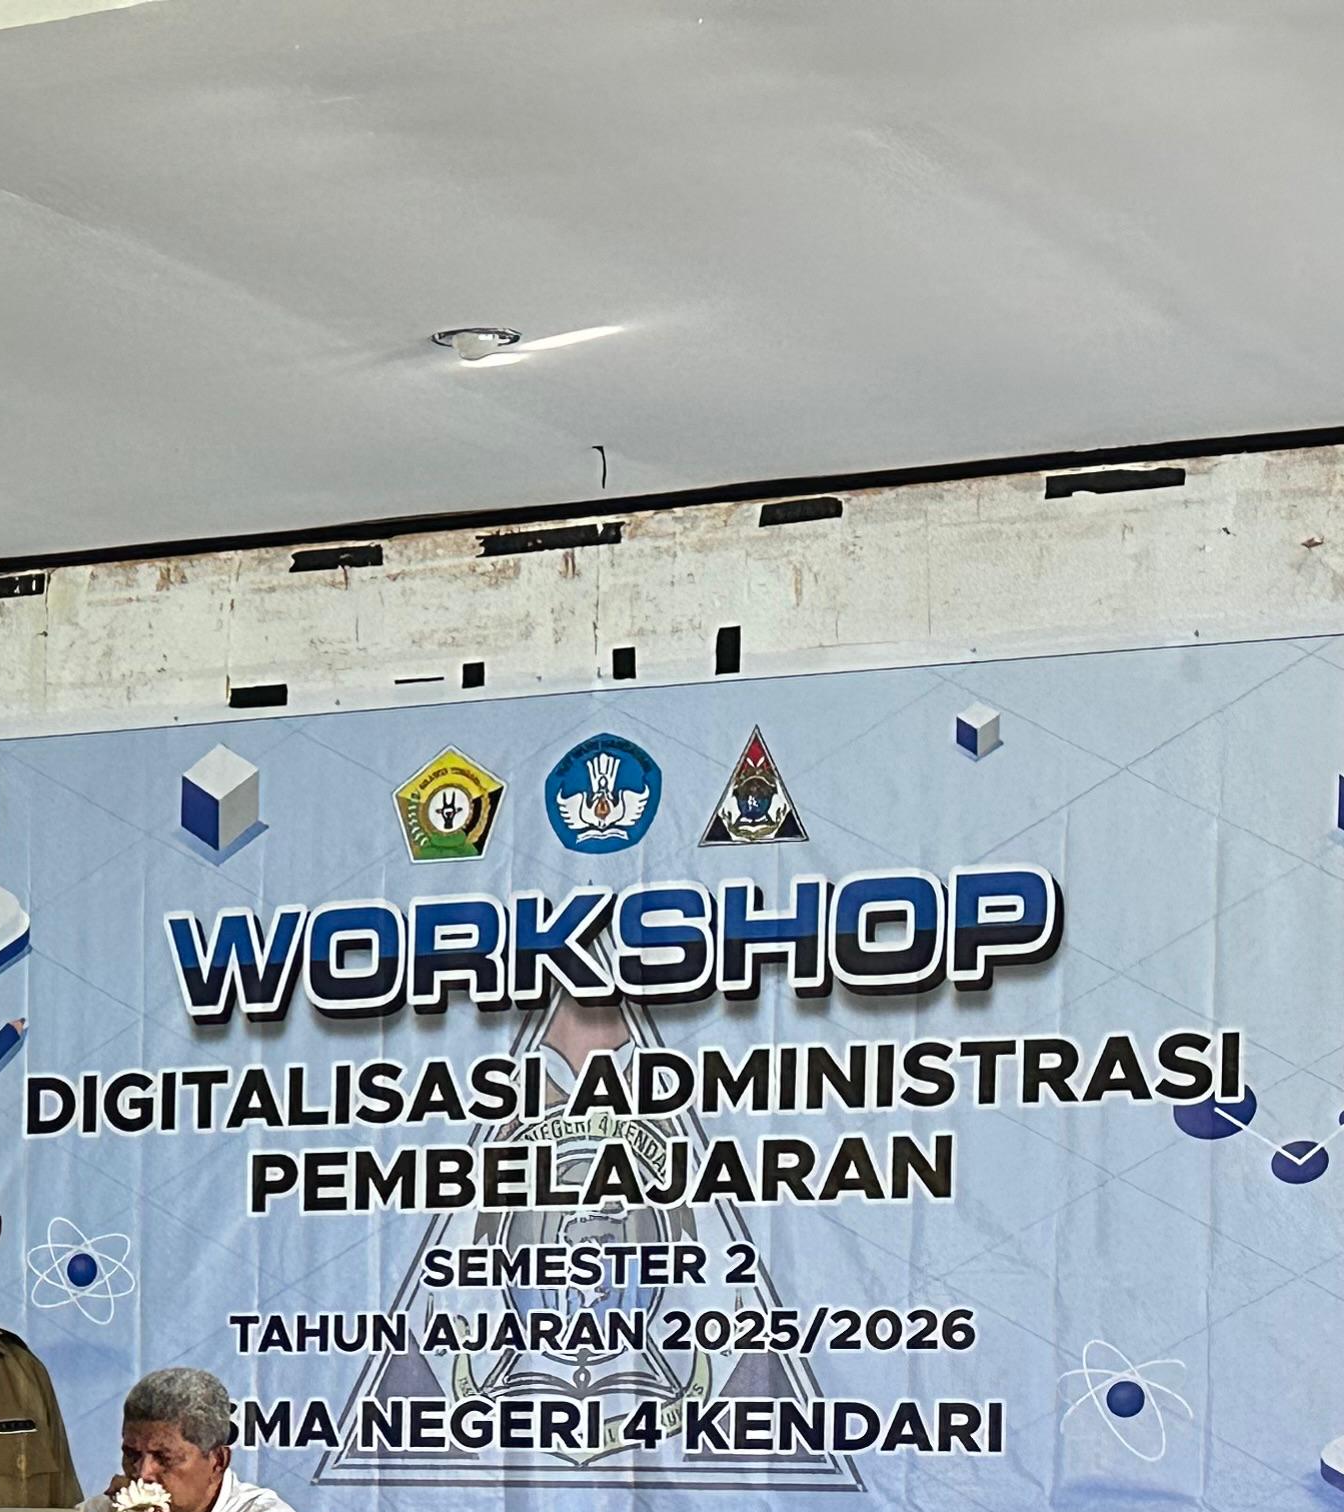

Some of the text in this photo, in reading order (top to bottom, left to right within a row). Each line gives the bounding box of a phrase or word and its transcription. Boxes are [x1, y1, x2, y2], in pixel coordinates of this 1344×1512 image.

[166, 866, 1066, 1024] WORKSHOP
[26, 1032, 1241, 1135] DIGITALISASI ADMINISTRASI
[252, 1135, 954, 1213] PEMBELAJARAN
[423, 1243, 756, 1288] SEMESTER 2
[229, 1308, 976, 1354] TAHUN AJARAN 2025/2026
[361, 1400, 600, 1449] NEGERI
[623, 1401, 662, 1449] 4
[686, 1401, 1002, 1453] KENDARI
